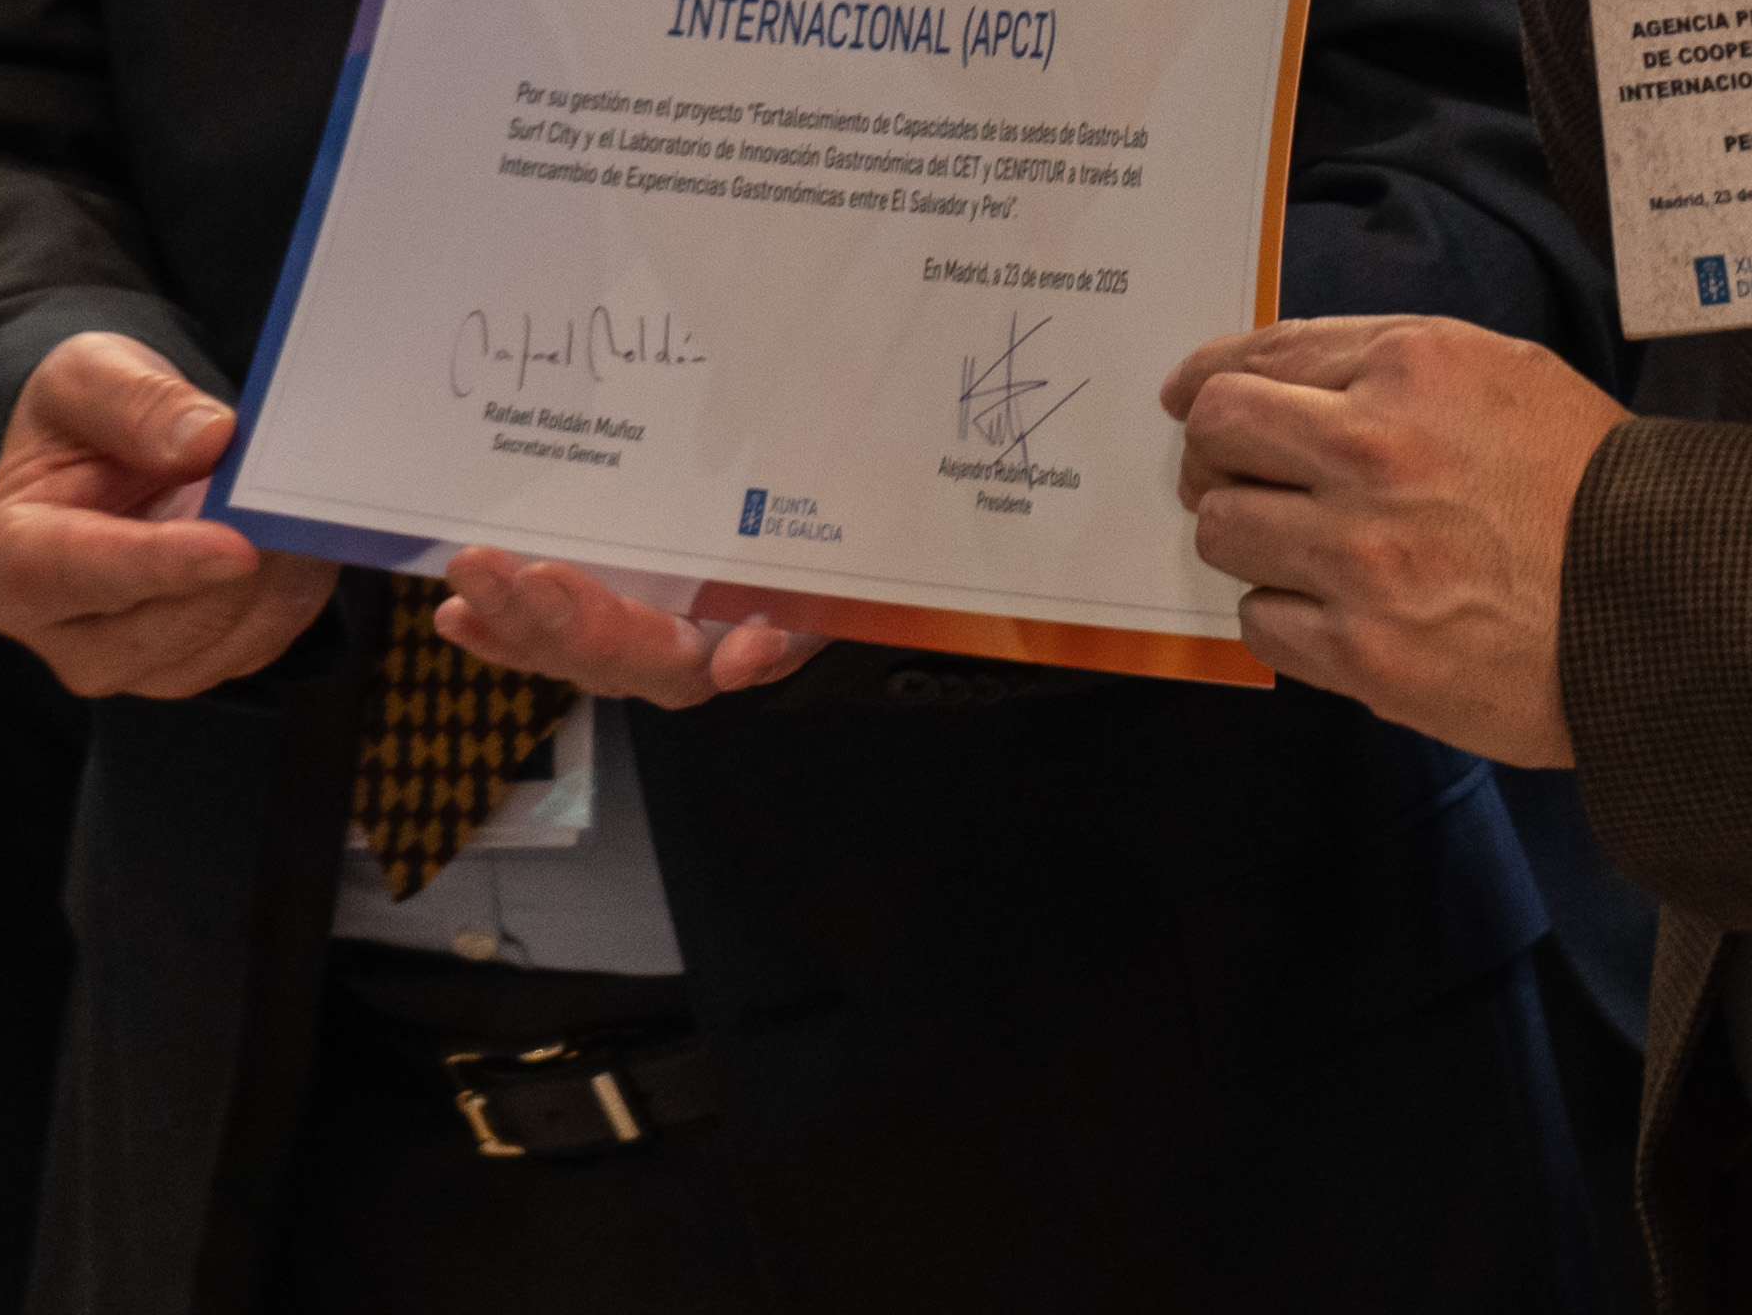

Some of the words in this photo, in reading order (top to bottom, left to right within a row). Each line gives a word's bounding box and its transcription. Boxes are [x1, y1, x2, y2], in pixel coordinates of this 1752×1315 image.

[962, 6, 1057, 71] (APCI)
[1632, 13, 1730, 39] AGENCIA
[1643, 50, 1672, 69] DE
[516, 81, 545, 105] Por
[548, 91, 568, 107] su
[570, 91, 630, 114] gestión
[633, 98, 653, 115] en
[656, 96, 672, 117] el
[674, 101, 744, 126] proyecto
[873, 115, 891, 135] de
[893, 112, 979, 141] Capacidades
[981, 120, 997, 141] de
[1000, 120, 1018, 142] las
[1021, 122, 1057, 145] sedes
[1058, 123, 1075, 146] de
[1077, 121, 1148, 148] Gastro-Lab
[508, 117, 545, 140] Surf
[548, 121, 581, 151] City
[582, 132, 594, 152] y
[599, 128, 615, 149] el
[619, 129, 711, 158] Laboratorio
[715, 139, 735, 160] de
[739, 140, 820, 167] Innovación
[824, 146, 924, 175] Gastronómica
[927, 154, 948, 176] del
[953, 154, 981, 178] CET
[982, 163, 992, 184] y
[994, 156, 1066, 183] CENFOTUR
[1067, 167, 1076, 183] a
[1080, 163, 1118, 186] través
[1122, 165, 1142, 187] del
[499, 154, 598, 184] Intercambio
[601, 165, 622, 187] de
[625, 166, 727, 197] Experiencias
[731, 175, 845, 208] Gastronómicas
[850, 189, 888, 210] entre
[891, 188, 905, 212] El
[909, 191, 969, 216] Salvador
[969, 201, 979, 221] y
[1713, 189, 1732, 204] 23
[923, 257, 940, 281] En
[944, 258, 989, 287] Madrid,
[992, 269, 1001, 286] a
[1003, 263, 1020, 287] 23
[1022, 264, 1036, 288] de
[1039, 271, 1074, 290] enero
[1077, 270, 1093, 291] de
[1095, 268, 1129, 294] 2025
[483, 401, 534, 425] Rafael
[537, 408, 591, 433] Roldán
[595, 418, 646, 441] Muñoz
[491, 433, 565, 459] Secretario
[567, 443, 622, 466] General
[769, 496, 818, 516] XUNTA
[976, 490, 1033, 515] Presidente
[765, 517, 786, 535] DE
[787, 520, 843, 542] GALICIA
